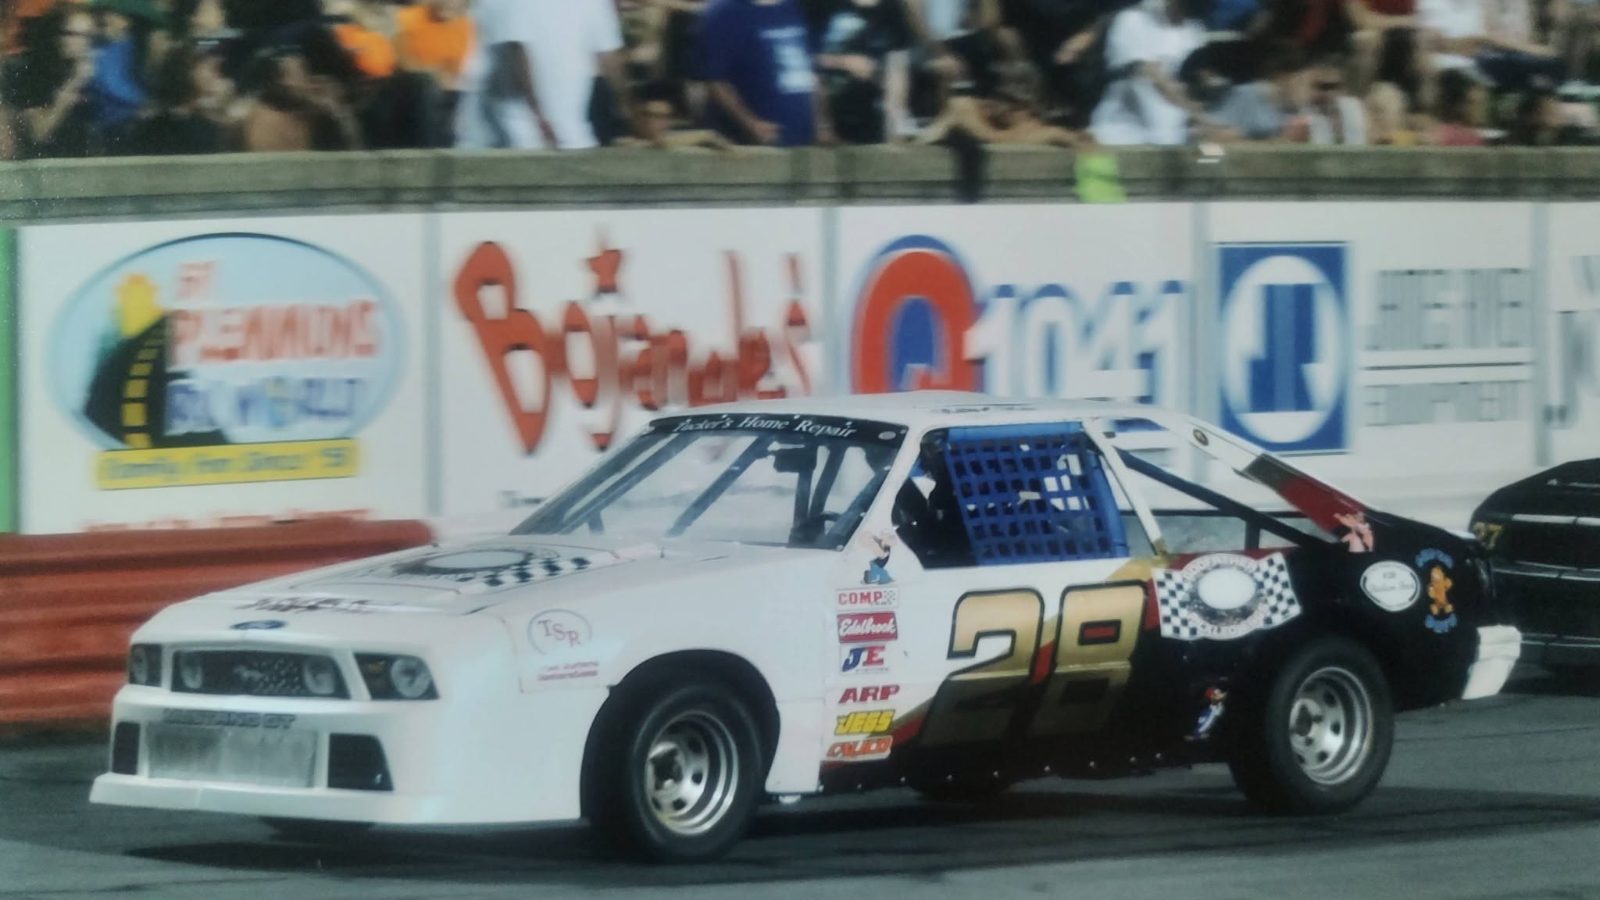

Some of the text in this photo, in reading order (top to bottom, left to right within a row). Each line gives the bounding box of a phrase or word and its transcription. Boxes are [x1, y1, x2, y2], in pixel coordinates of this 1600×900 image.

[738, 416, 790, 430] Home
[795, 419, 856, 438] Repair
[838, 591, 883, 605] COMP
[839, 616, 897, 637] Edelbrock
[842, 645, 886, 672] JE
[918, 578, 1148, 748] 28
[838, 684, 900, 704] ARP
[834, 709, 896, 736] JEGS
